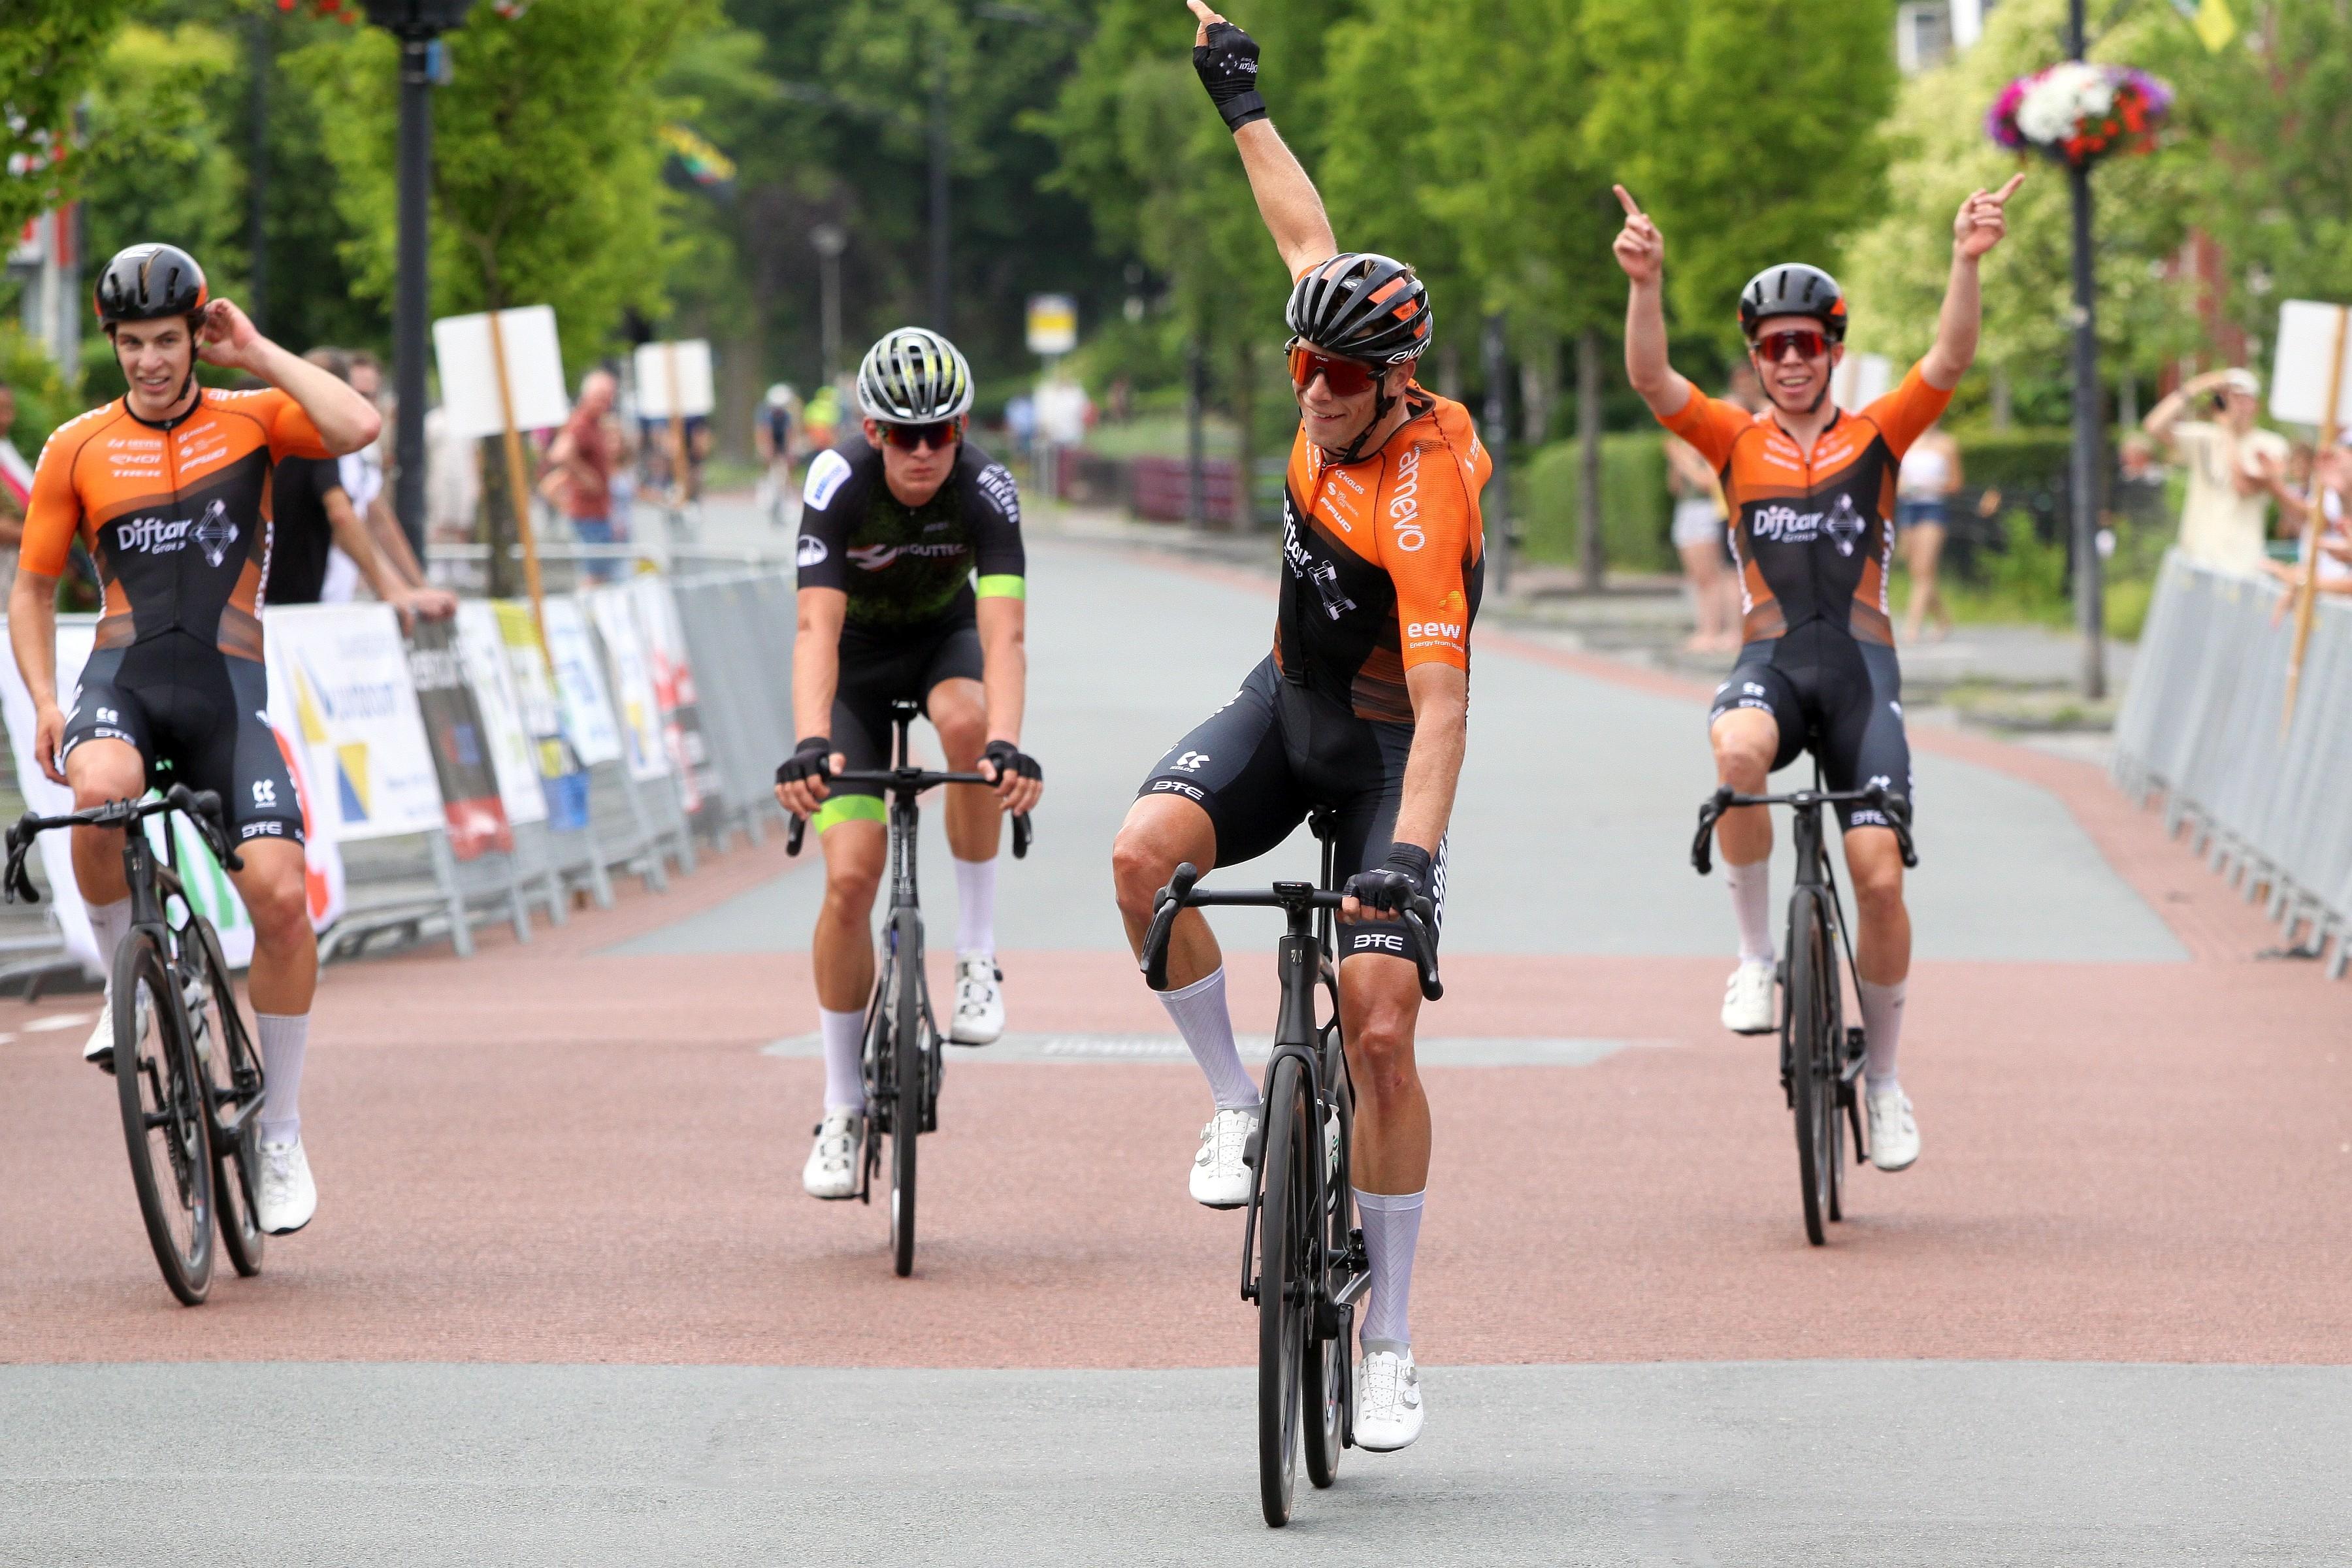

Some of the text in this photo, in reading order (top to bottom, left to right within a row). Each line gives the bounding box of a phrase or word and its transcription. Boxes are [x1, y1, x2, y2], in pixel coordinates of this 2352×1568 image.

[1390, 446, 1426, 552] amevo
[117, 517, 193, 553] Diftar
[1283, 489, 1312, 566] iftar
[1753, 505, 1824, 541] Diftar
[1407, 622, 1462, 639] eew
[1152, 781, 1205, 801] DTE
[1353, 934, 1404, 951] DTE
